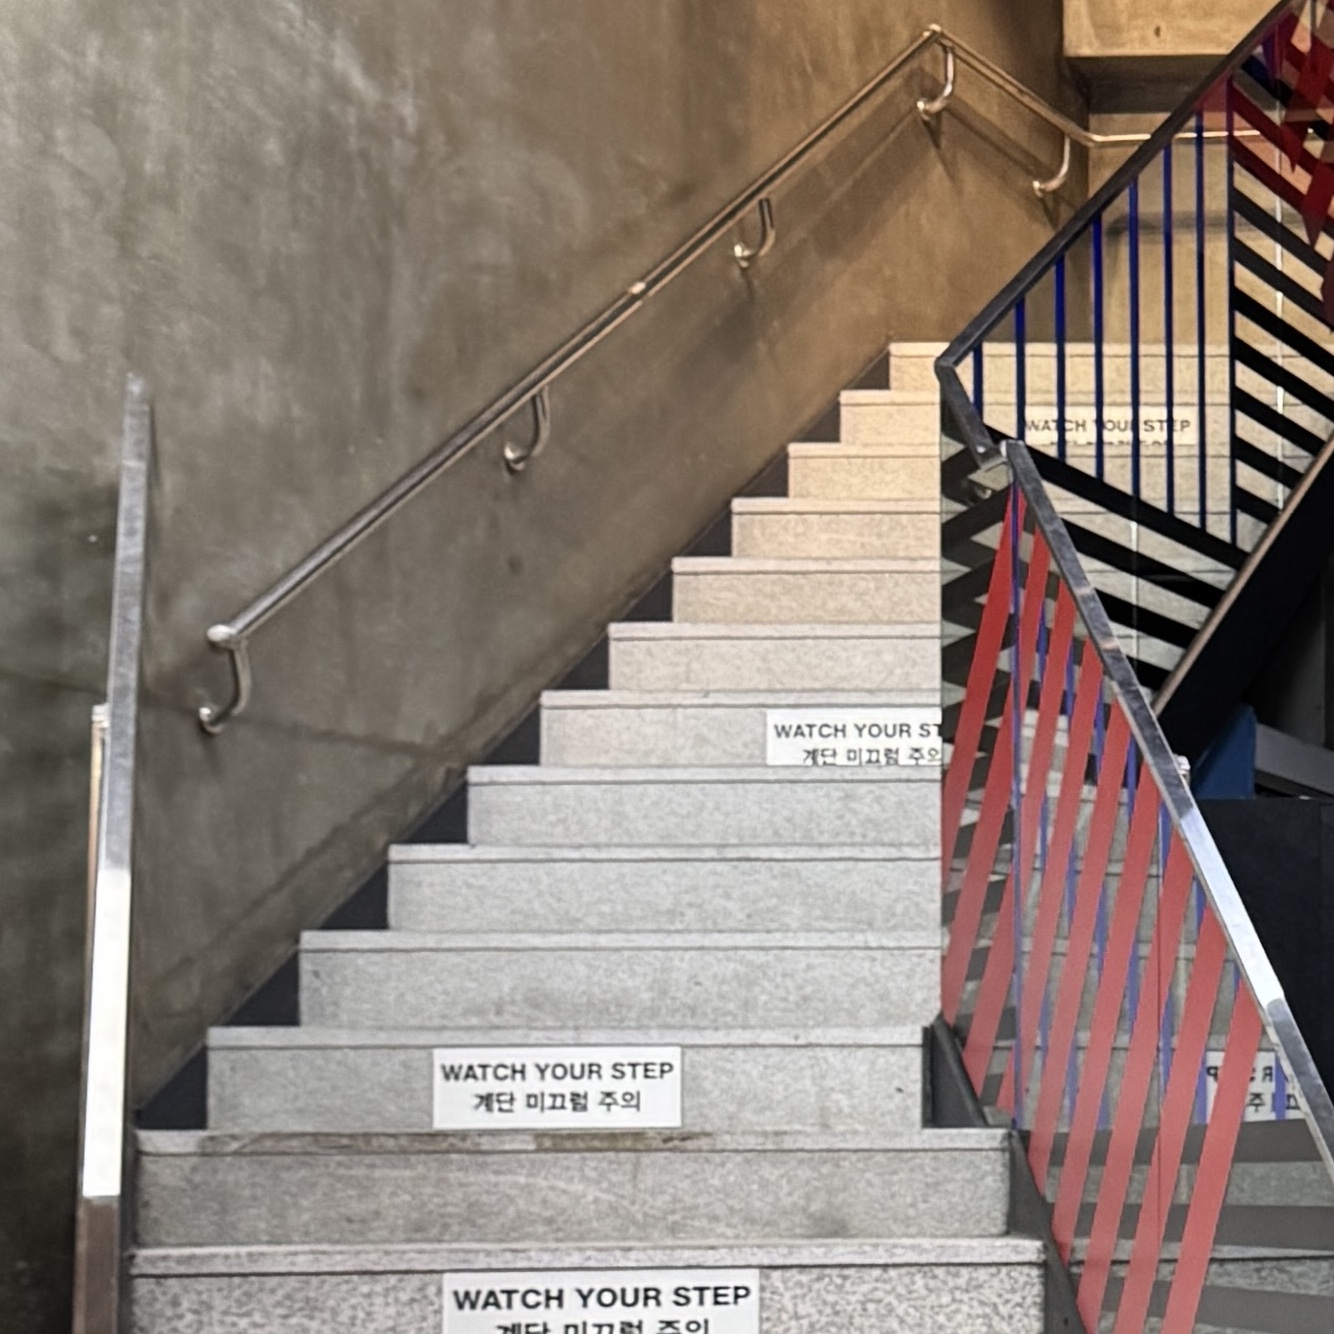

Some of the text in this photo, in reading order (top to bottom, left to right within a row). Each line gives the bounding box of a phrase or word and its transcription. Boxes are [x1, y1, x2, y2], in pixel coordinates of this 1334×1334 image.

[773, 723, 847, 739] WATCH
[854, 723, 912, 738] YOUR
[803, 747, 837, 765] 계단
[846, 747, 899, 765] 미끄럼
[440, 1061, 674, 1082] WATCH YOUR STEP
[474, 1090, 641, 1113] 계단 미끄럼 주의
[453, 1286, 751, 1311] WATCH YOUR STEP
